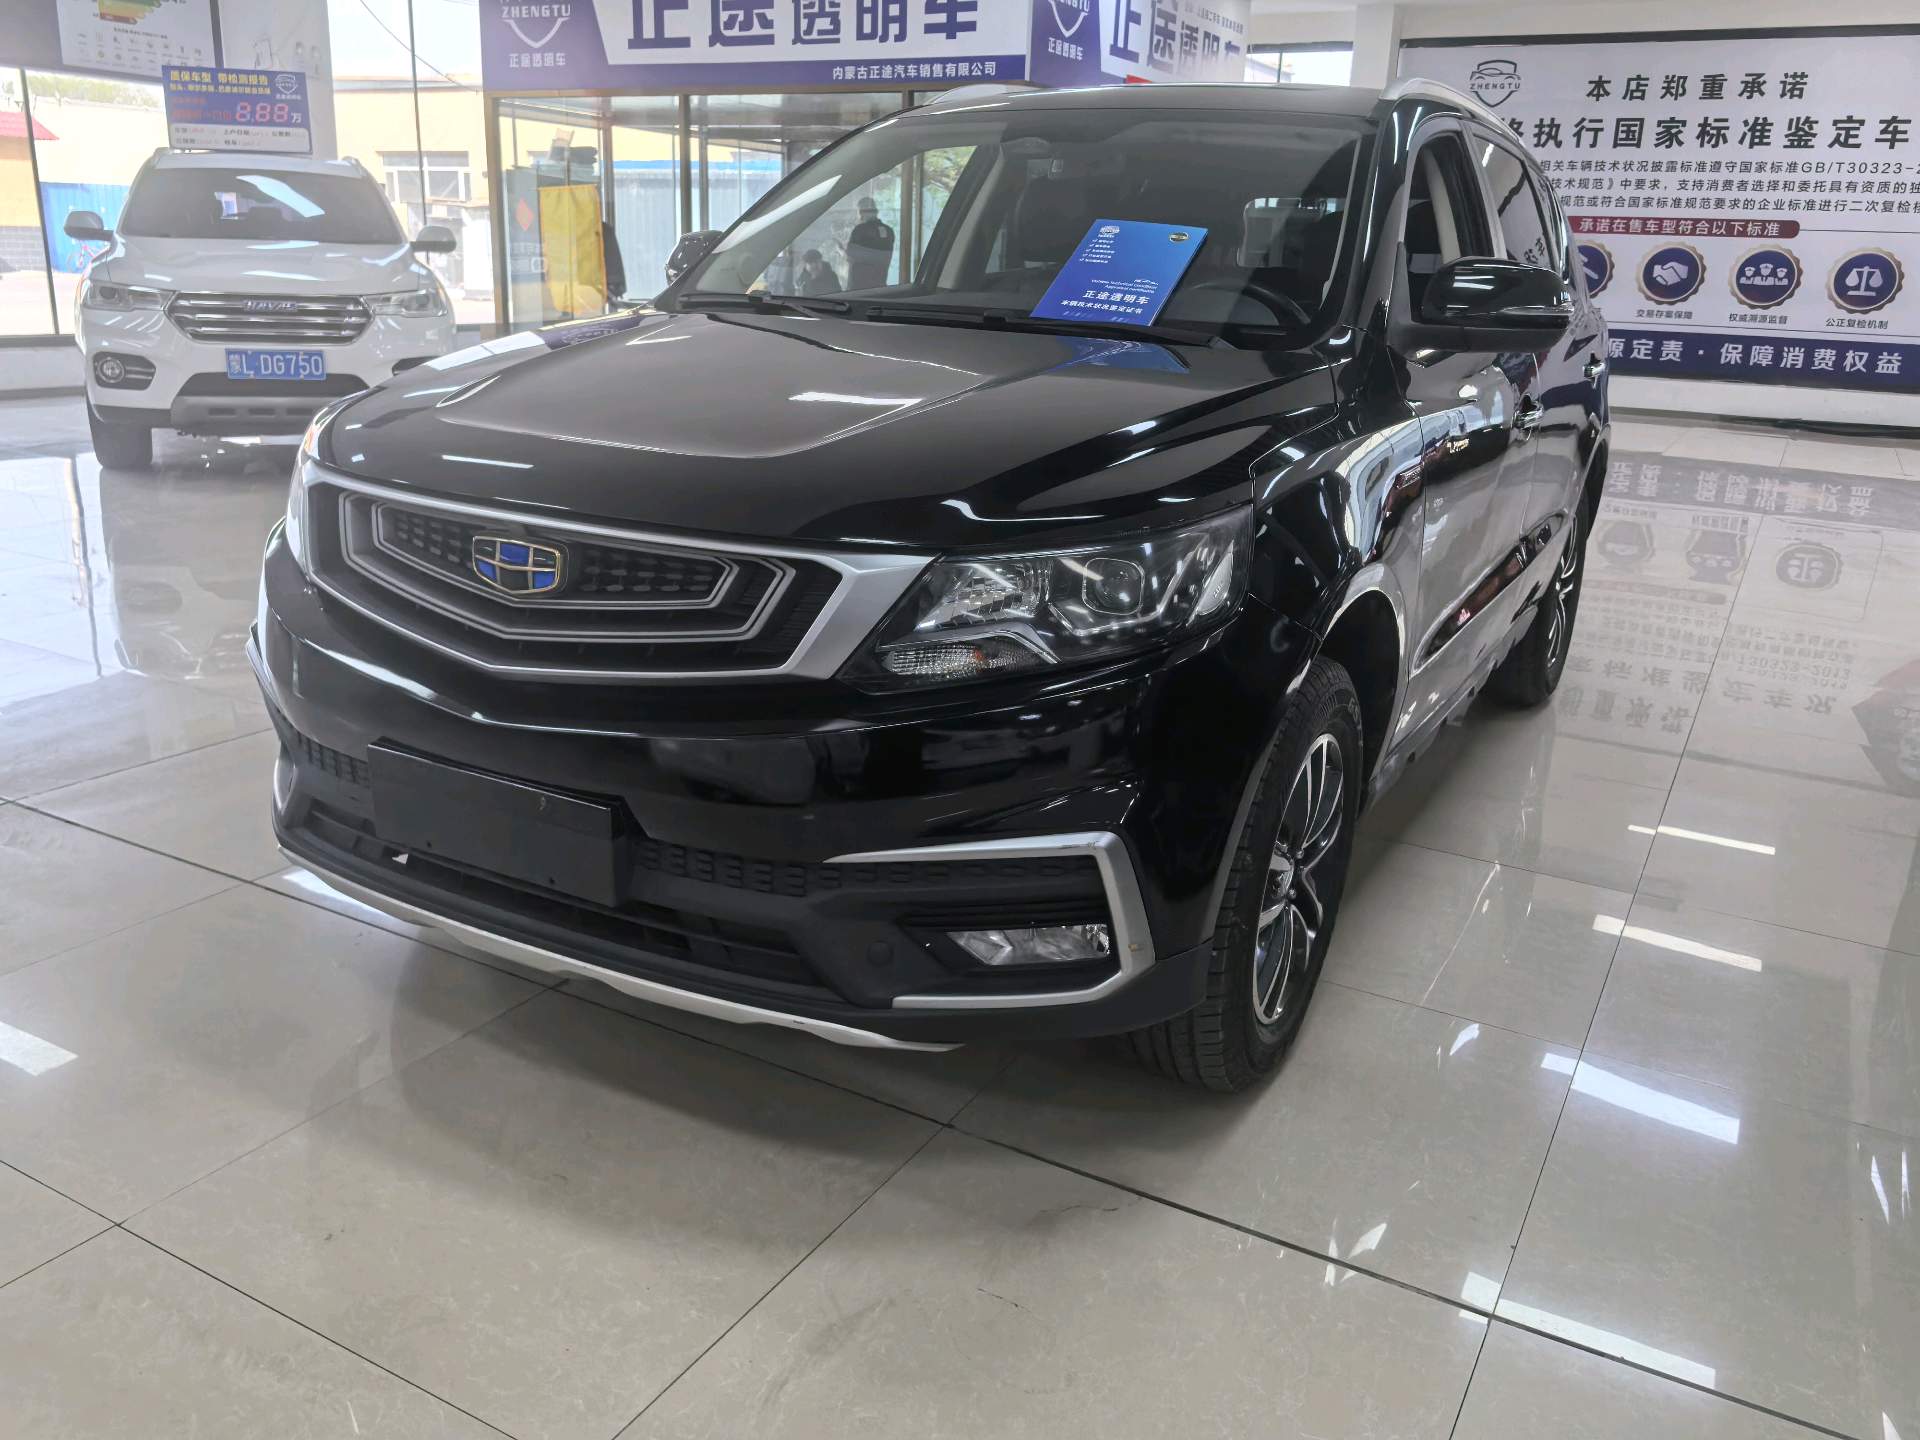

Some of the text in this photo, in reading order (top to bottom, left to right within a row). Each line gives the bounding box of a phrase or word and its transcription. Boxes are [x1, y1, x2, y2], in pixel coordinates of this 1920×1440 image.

[501, 4, 571, 18] ZHENGTU
[508, 52, 567, 68] 正途透明车
[832, 61, 996, 80] 内蒙古正途汽车销售有限公司
[1469, 82, 1521, 90] ZHENGTU
[1585, 71, 1809, 102] 本店郑重承诺
[1540, 159, 1920, 175] 相关车辆技术状况披露标准遵守国家标准GB/T30323-
[1578, 218, 1781, 236] 承诺在售车型符合以下标准
[1082, 290, 1151, 305] 正途透明车
[1825, 318, 1889, 330] 公正复检机制
